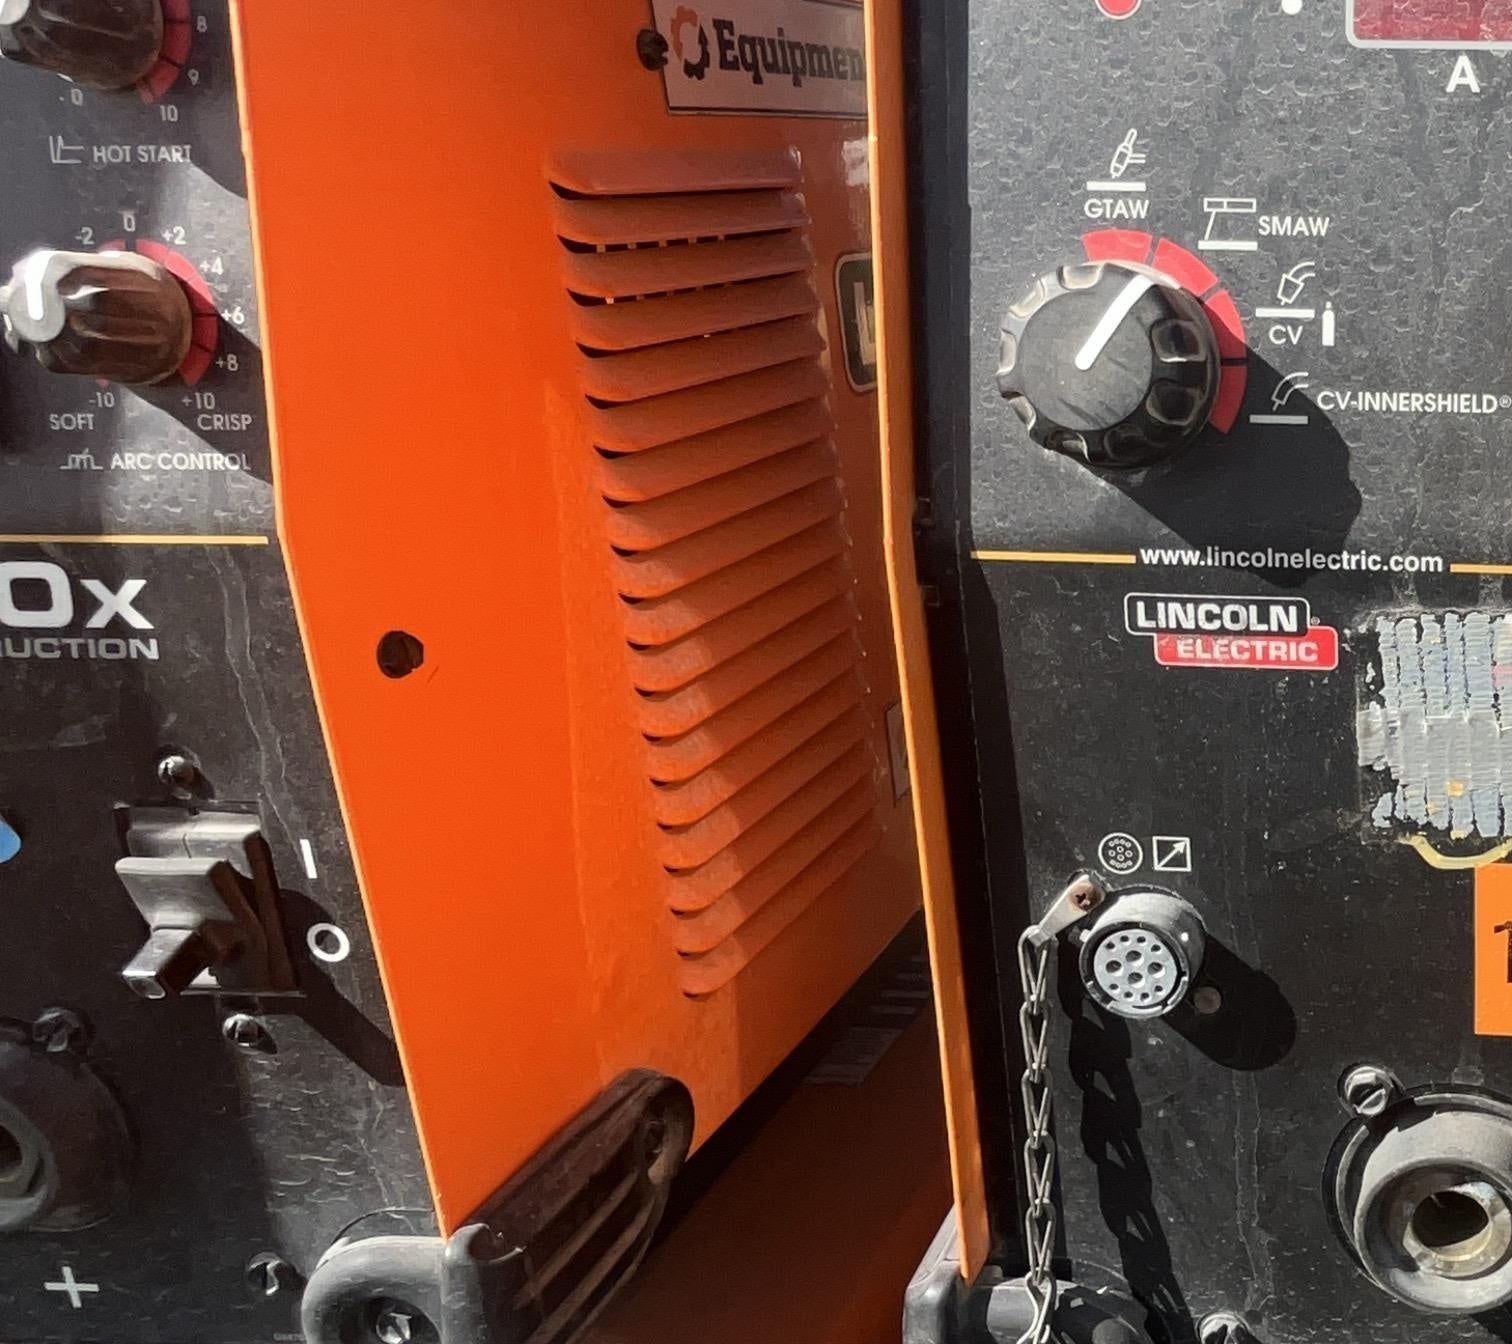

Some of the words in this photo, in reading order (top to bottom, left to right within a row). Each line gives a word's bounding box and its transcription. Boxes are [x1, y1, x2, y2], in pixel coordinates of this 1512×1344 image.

[196, 15, 207, 32] 8
[187, 68, 199, 85] 9
[1445, 58, 1481, 95] A
[70, 88, 83, 106] 0
[159, 105, 179, 122] 10
[92, 145, 131, 164] HOT
[136, 145, 192, 164] START
[1083, 199, 1150, 219] GTAW
[122, 214, 136, 232] 0
[1258, 216, 1330, 237] SMAW
[75, 227, 95, 245] -2
[161, 226, 187, 245] +2
[200, 257, 224, 275] +4
[221, 307, 245, 324] +6
[1268, 325, 1304, 346] CV
[215, 354, 239, 371] +8
[88, 392, 115, 408] -10
[181, 392, 216, 410] +10
[50, 413, 95, 431] SOFT
[197, 413, 253, 431] CRISP
[110, 452, 153, 470] ARC
[158, 452, 252, 471] CONTROL
[1140, 546, 1444, 574] www.lincolnelectric.com
[1136, 601, 1299, 632] LINCOLN
[0, 637, 160, 661] UCTION
[1176, 638, 1319, 663] ELECTRIC
